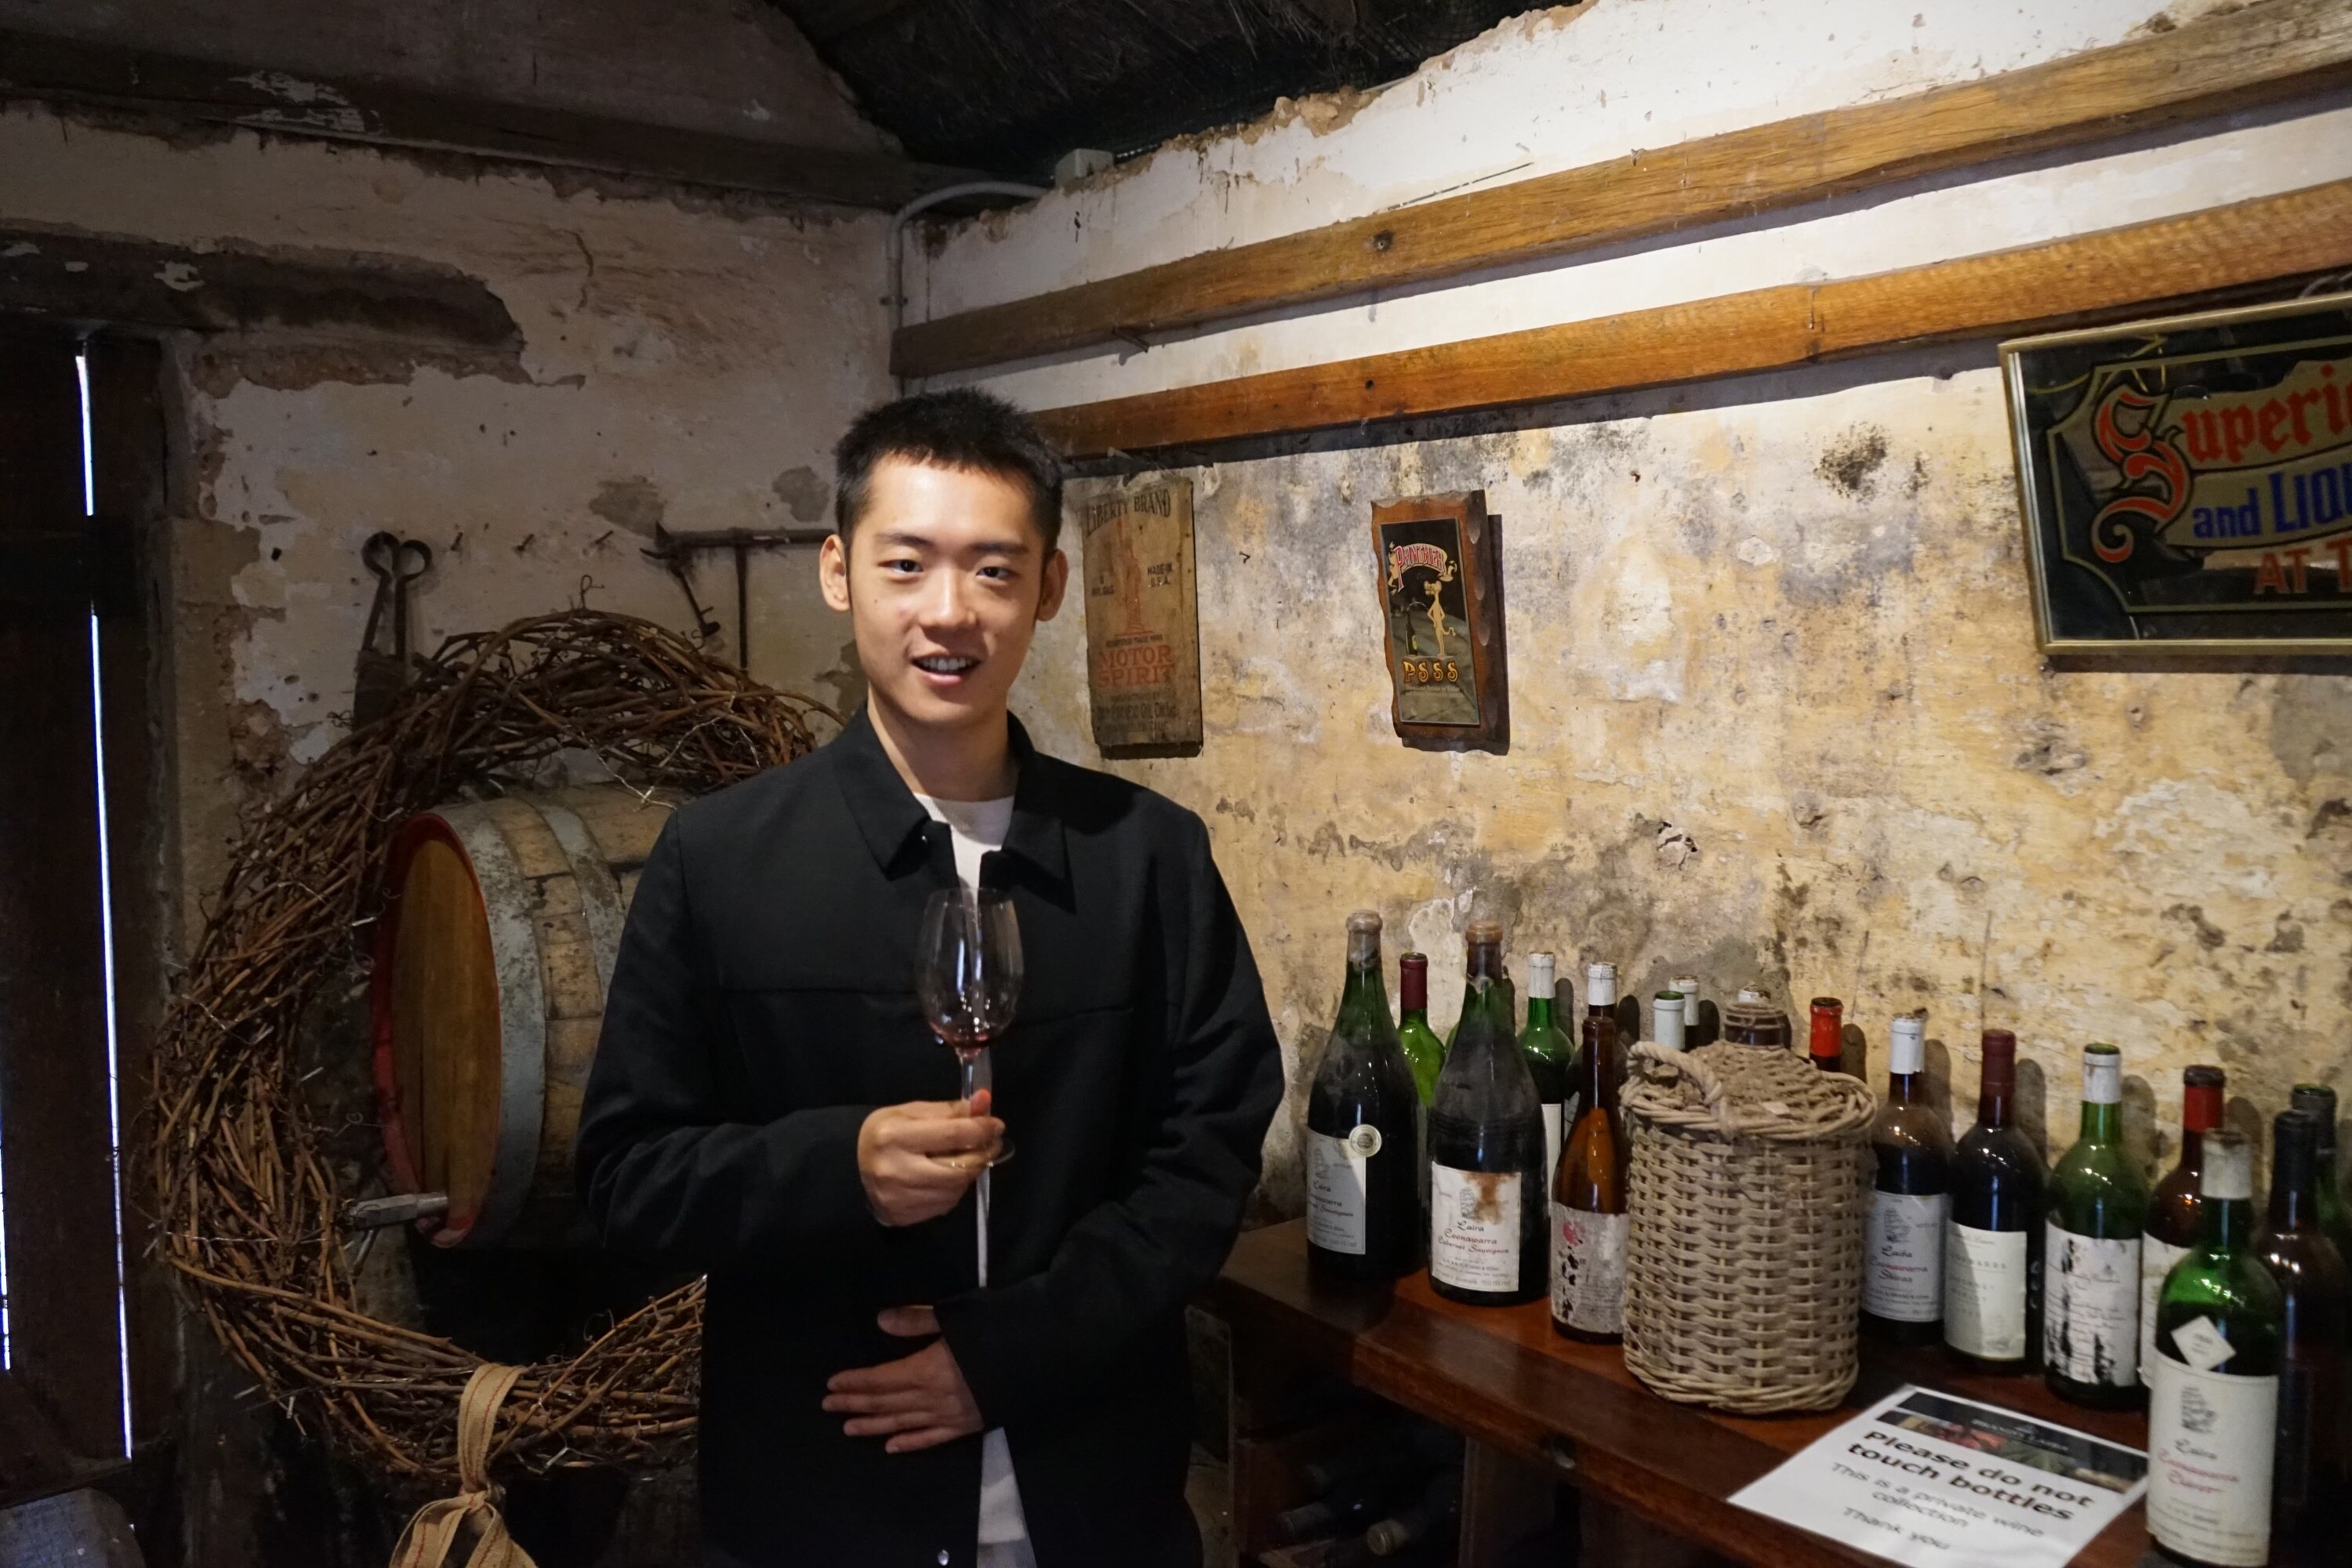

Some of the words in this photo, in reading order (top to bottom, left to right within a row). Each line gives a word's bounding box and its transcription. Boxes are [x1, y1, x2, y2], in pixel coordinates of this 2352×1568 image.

[2091, 364, 2352, 563] Superi
[1134, 488, 1171, 517] BRAND
[2192, 487, 2261, 539] and
[1393, 546, 1446, 593] PANTHER
[2253, 548, 2311, 594] AT
[1098, 644, 1174, 669] MOTOR
[1098, 663, 1175, 688] SPIRIT
[1437, 1236, 1465, 1250] Cabernet
[1468, 1244, 1509, 1256] Sauvignon
[1444, 1228, 1497, 1245] Coonawarra
[1457, 1220, 1484, 1232] Laira
[1846, 1443, 1942, 1480] touch
[1949, 1475, 2076, 1520] bottles
[1863, 1429, 1970, 1470] Please
[1977, 1466, 2024, 1486] do
[2031, 1483, 2096, 1508] not
[1831, 1461, 1871, 1483] This
[1874, 1477, 1892, 1490] is
[1896, 1485, 1911, 1495] a
[1912, 1490, 1987, 1519] private
[1991, 1515, 2045, 1537] wine
[1871, 1490, 1970, 1529] collection
[1842, 1505, 1904, 1535] Thank
[1907, 1530, 1952, 1552] you
